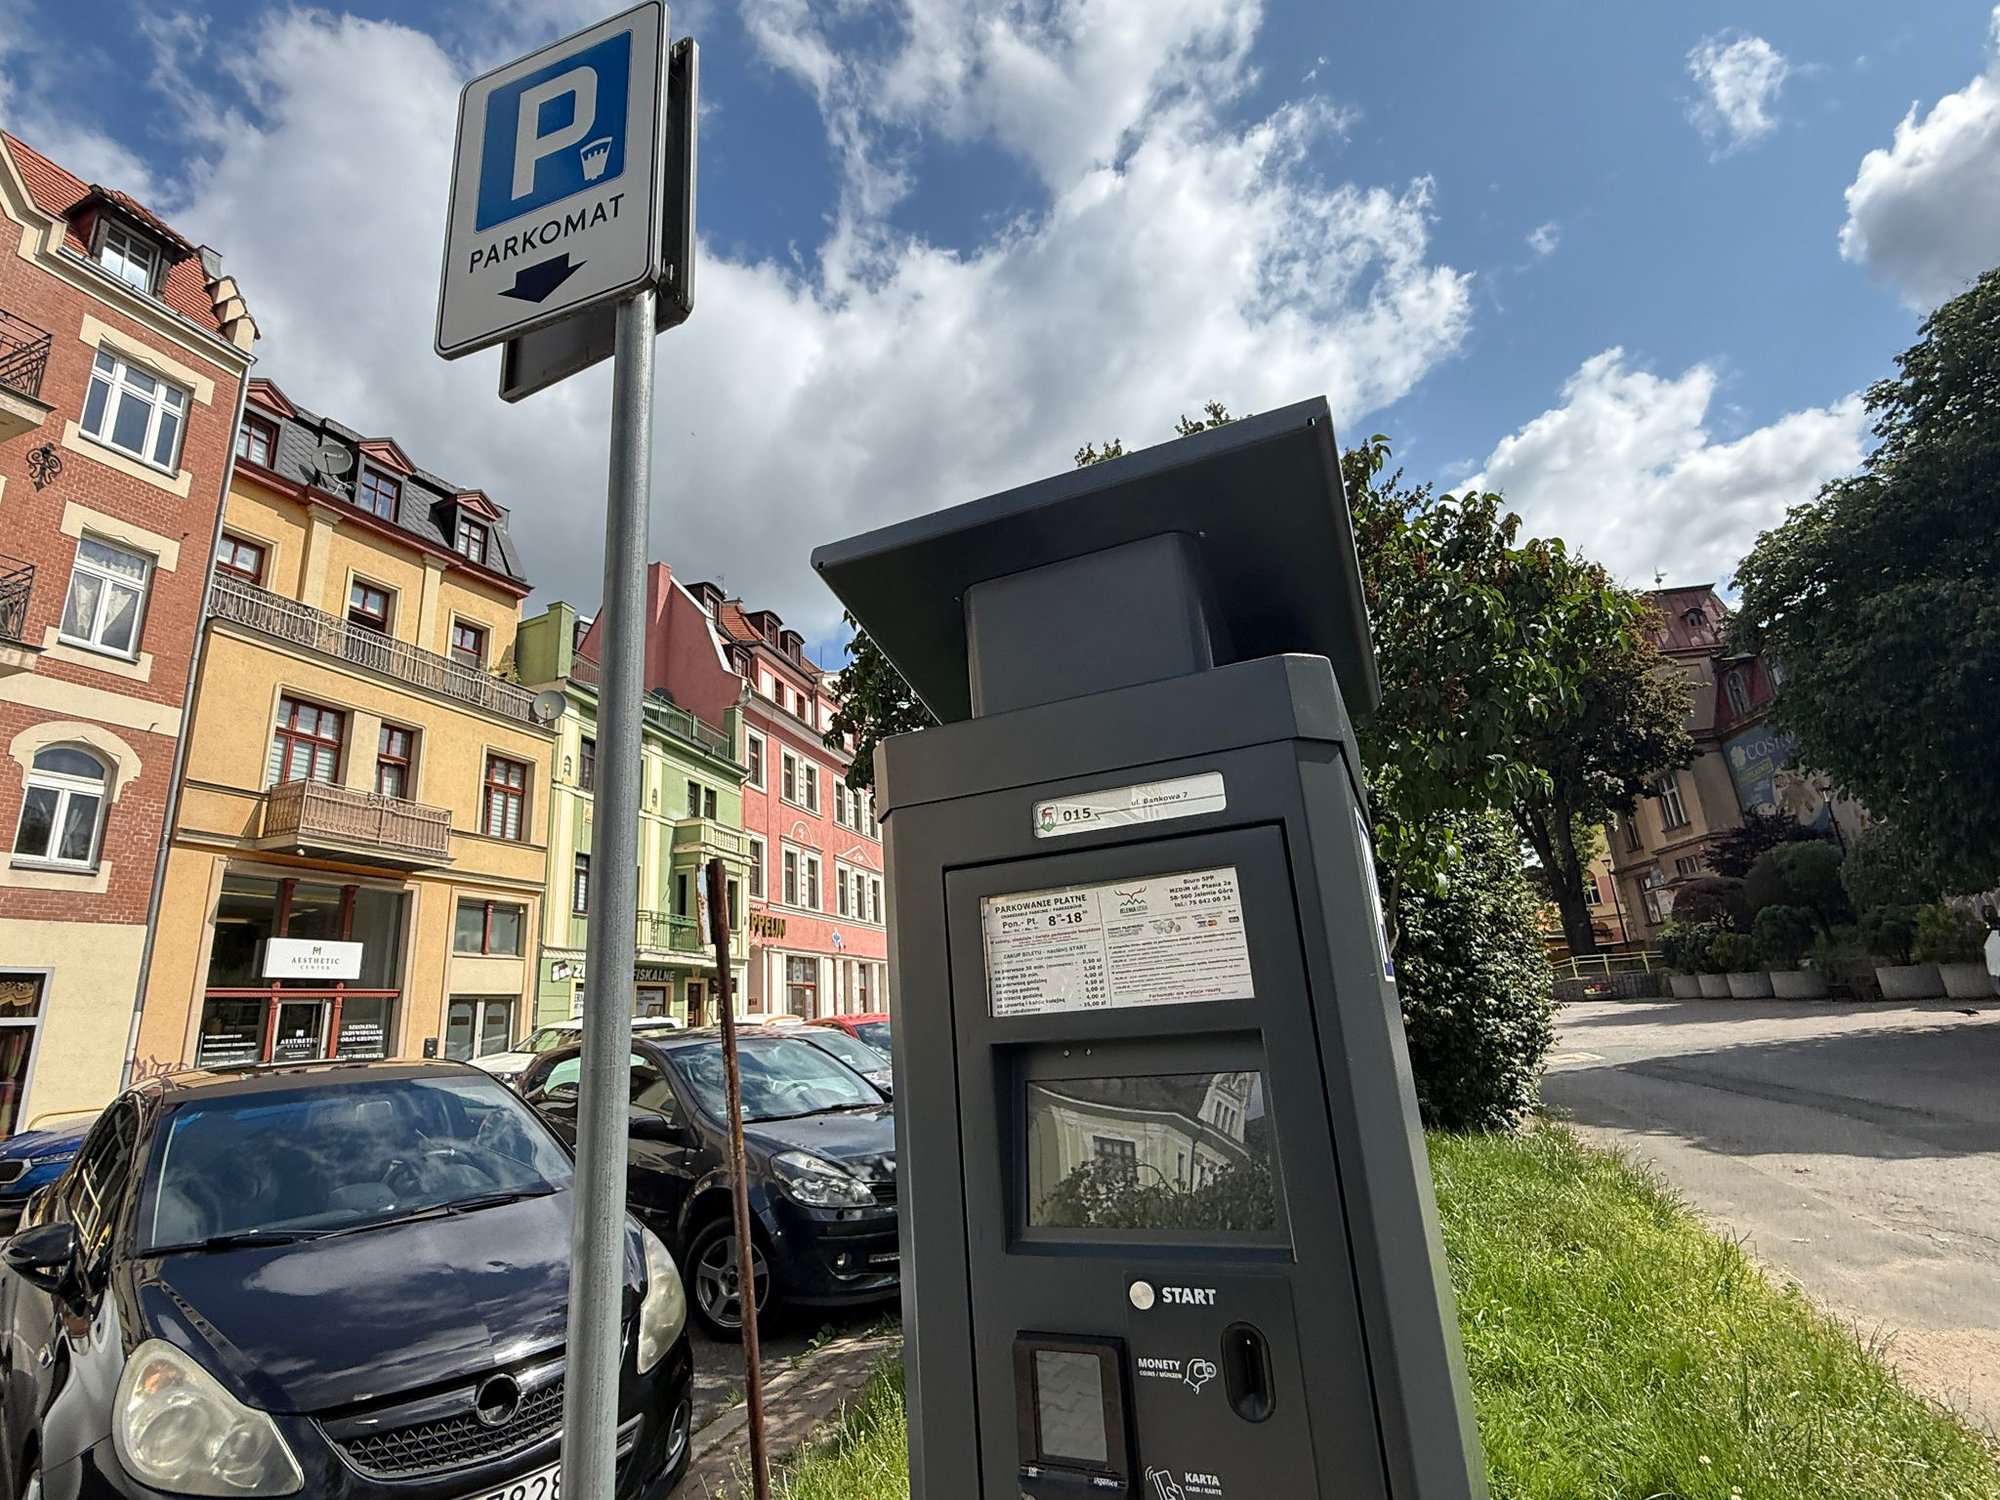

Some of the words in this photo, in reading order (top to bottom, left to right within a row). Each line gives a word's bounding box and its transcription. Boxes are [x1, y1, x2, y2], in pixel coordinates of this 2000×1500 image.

[511, 65, 598, 201] P
[469, 193, 625, 274] PARKOMAT
[1143, 792, 1181, 805] Bankowa
[1183, 791, 1188, 799] 7
[1063, 807, 1092, 822] 015
[1202, 881, 1222, 890] Ptasia
[1170, 893, 1193, 901] 58-500
[1194, 890, 1217, 898] Jelenia
[1218, 887, 1234, 895] Góra
[995, 899, 1052, 914] PARKOWANIE
[1054, 894, 1087, 906] PŁATNE
[750, 912, 786, 938] PPELIN
[1026, 918, 1038, 926] Pt.
[291, 957, 341, 965] AESTHETIC
[1022, 950, 1042, 958] BILETU
[634, 968, 676, 982] FISKALNE
[1162, 1287, 1216, 1305] START
[1138, 1358, 1180, 1370] MONETY
[1184, 1472, 1220, 1486] KARTA
[1186, 1485, 1200, 1493] CARD
[1204, 1487, 1223, 1496] KARTE
